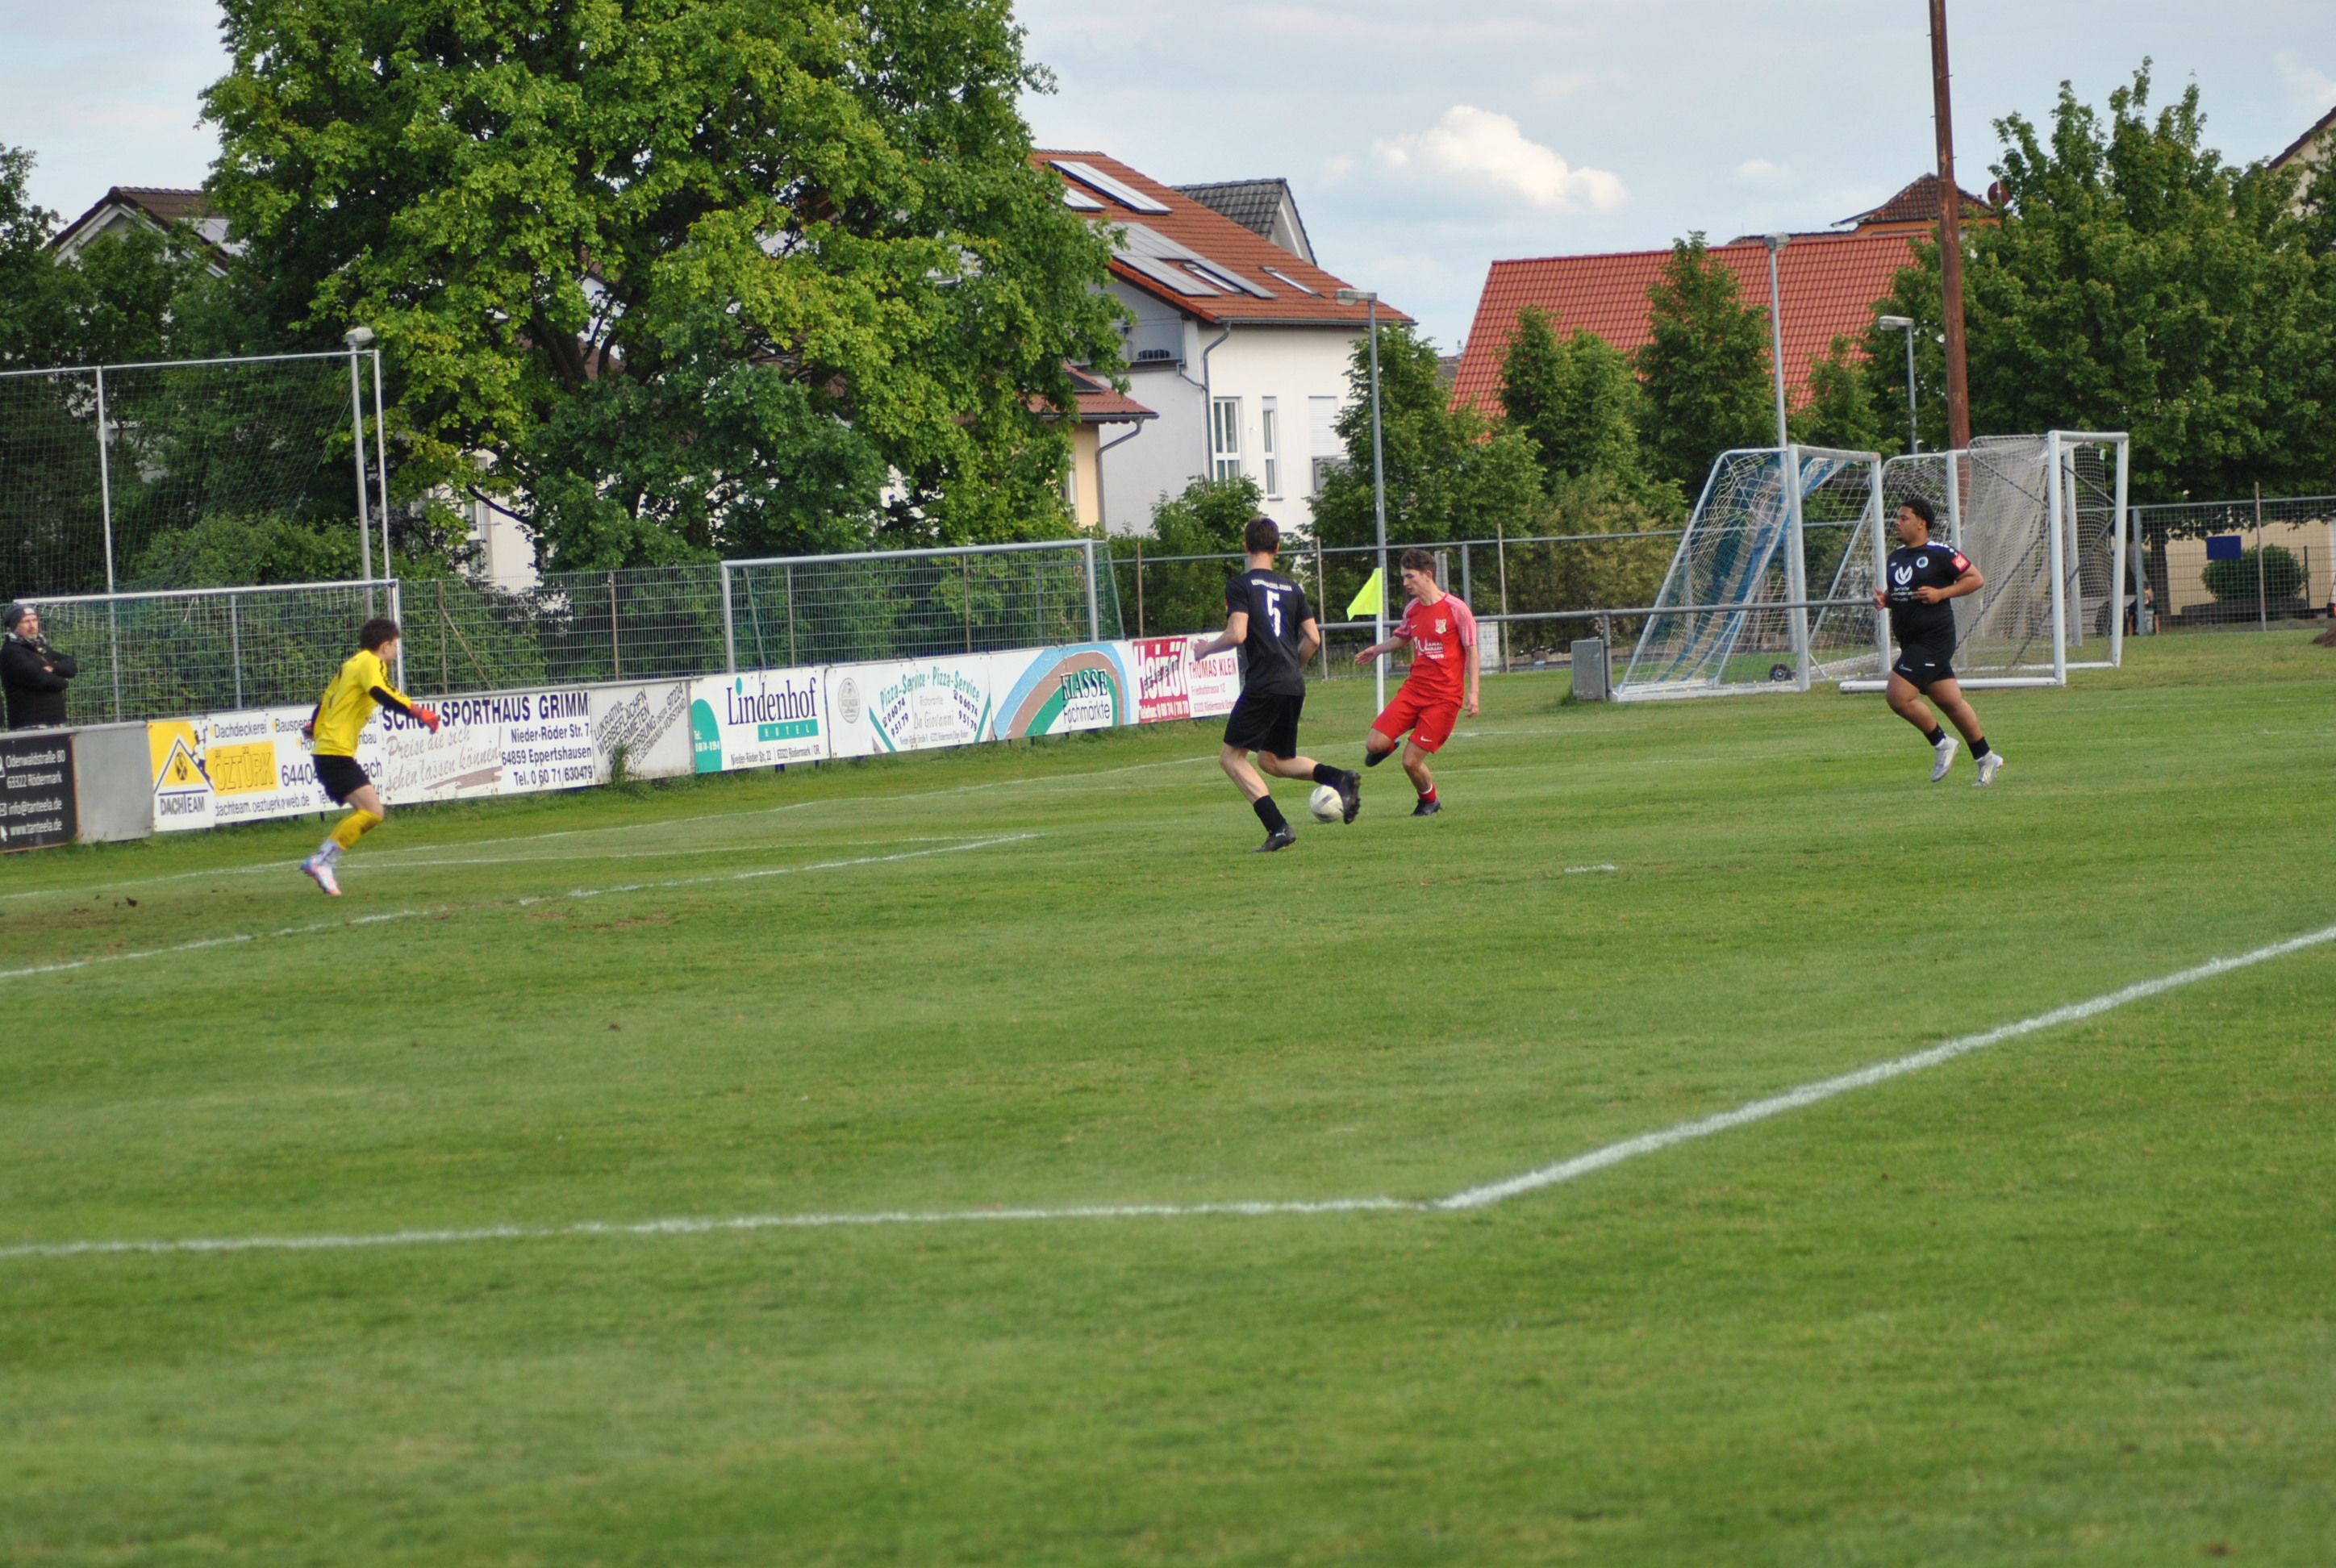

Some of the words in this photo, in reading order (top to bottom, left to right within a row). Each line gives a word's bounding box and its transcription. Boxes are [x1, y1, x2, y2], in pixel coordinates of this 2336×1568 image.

[1266, 590, 1281, 637] 5
[1188, 659, 1217, 679] THOMAS
[1219, 657, 1237, 676] KLEIN
[880, 669, 925, 712] Pizza-Service
[932, 665, 980, 702] Pizza-Service
[1060, 669, 1108, 701] KLASSE
[539, 692, 588, 719] GRIMM
[726, 677, 817, 725] Lindenhof
[1063, 699, 1110, 724] Fachmärkte
[215, 720, 267, 738] Dachdeckerei
[511, 725, 567, 743] Nieder-Röder
[569, 724, 583, 738] Str.
[585, 723, 590, 736] 7
[594, 701, 624, 741] LUKRATIVE
[597, 687, 647, 757] WERBEFLÄCHEN
[386, 736, 425, 765] Preise
[428, 732, 444, 750] die
[448, 725, 470, 746] sich
[502, 749, 527, 765] 64859
[528, 746, 592, 767] Eppertshausen
[6, 750, 56, 768] Odenwaldstraße
[57, 750, 65, 762] 80
[215, 747, 274, 790] ÖZTÜRK
[6, 774, 27, 789] 63322
[27, 771, 62, 786] Rödermark
[385, 763, 418, 791] sehen
[420, 759, 455, 782] lassen
[514, 771, 529, 786] Tel.
[8, 798, 62, 815] info@tanteela.de
[160, 794, 205, 815] DACHTEAM
[10, 818, 62, 836] www.tanteela.de
